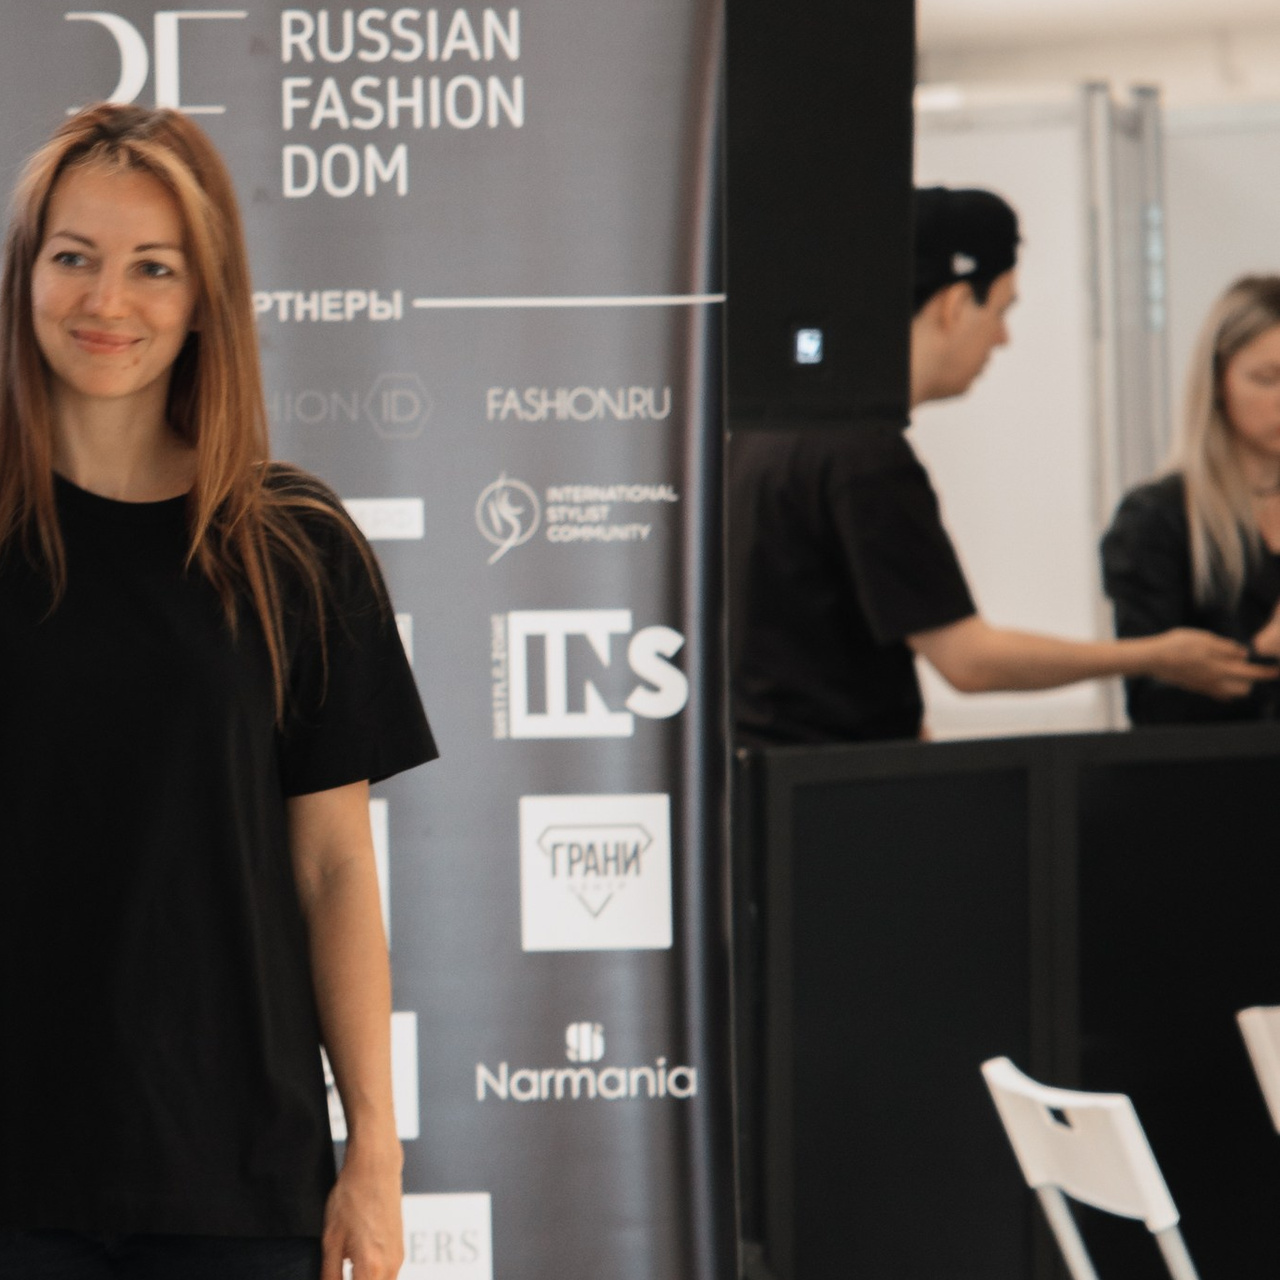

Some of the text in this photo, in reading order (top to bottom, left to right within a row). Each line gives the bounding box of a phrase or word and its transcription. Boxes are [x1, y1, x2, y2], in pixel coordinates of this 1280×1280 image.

[281, 7, 520, 63] RUSSIAN
[282, 74, 525, 131] FASHION
[282, 143, 408, 198] DOM
[252, 289, 403, 322] РТНЕРЫ
[546, 484, 678, 503] INTERNATIONAL
[546, 504, 610, 522] STYLIST
[546, 523, 652, 543] COMMUNITY
[550, 842, 641, 878] ГРАНИ
[476, 1056, 698, 1102] Narmania
